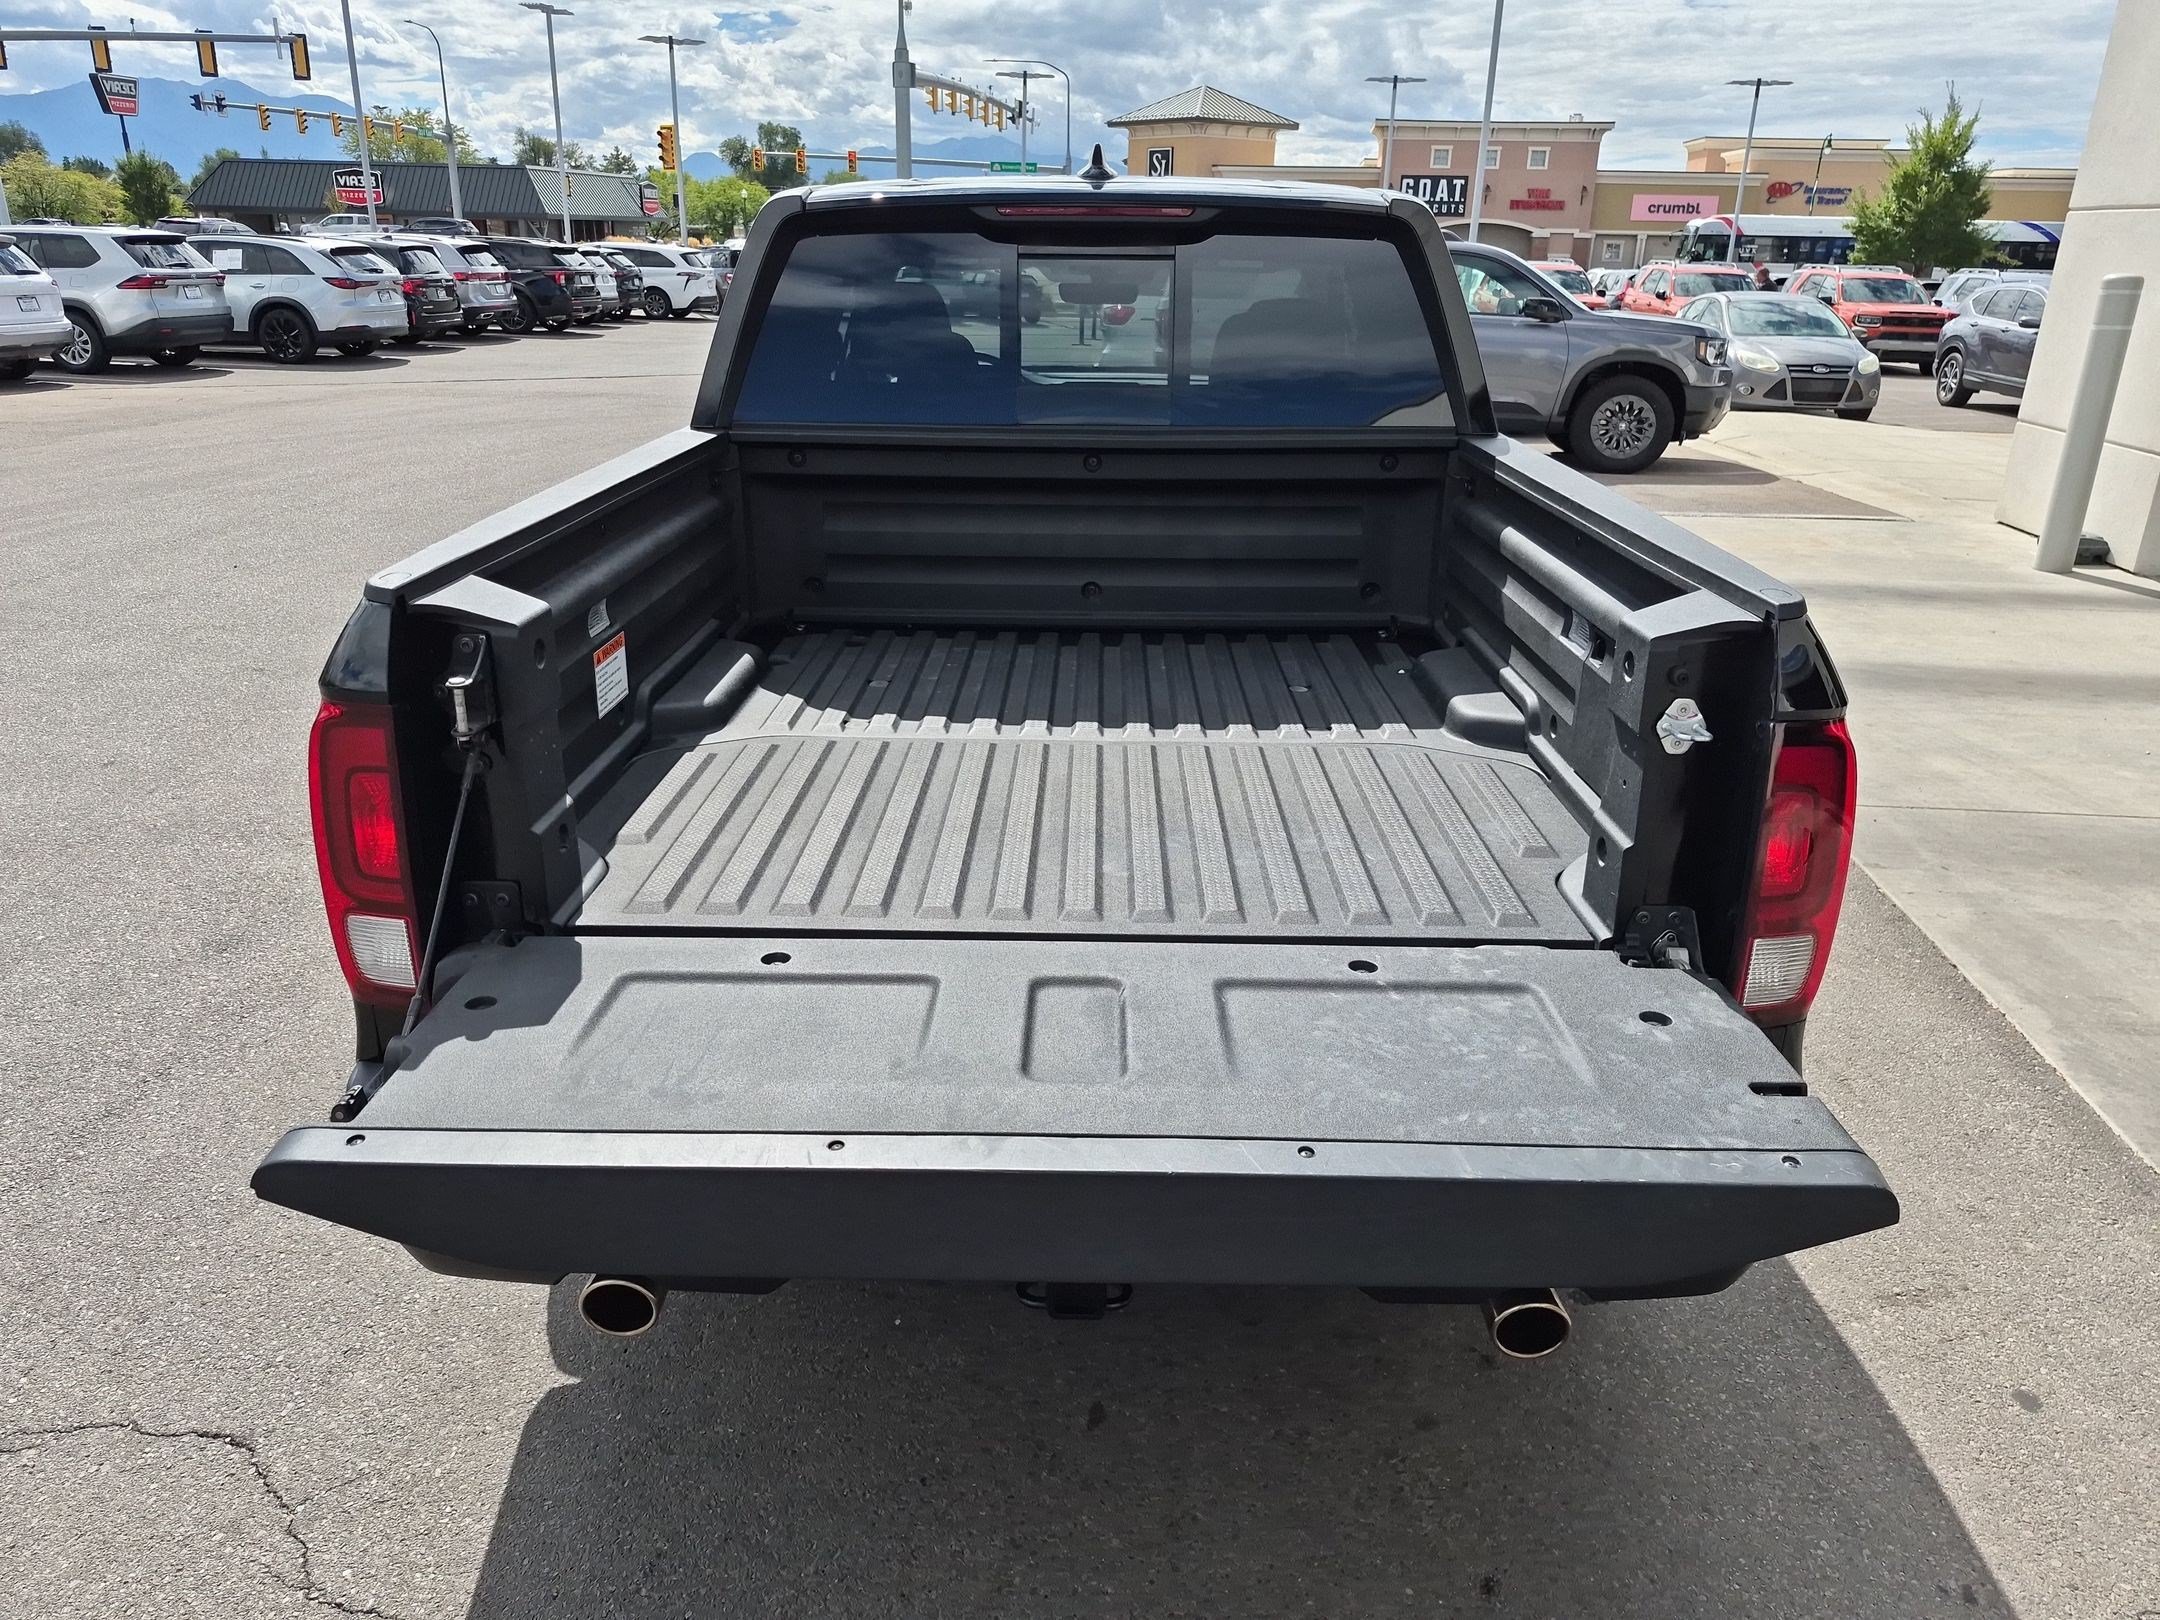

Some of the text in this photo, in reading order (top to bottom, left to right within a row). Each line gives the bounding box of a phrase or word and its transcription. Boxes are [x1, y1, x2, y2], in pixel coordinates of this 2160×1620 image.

[336, 175, 377, 187] VIA33
[1804, 185, 1852, 194] Inurance
[1648, 202, 1702, 215] crumbl
